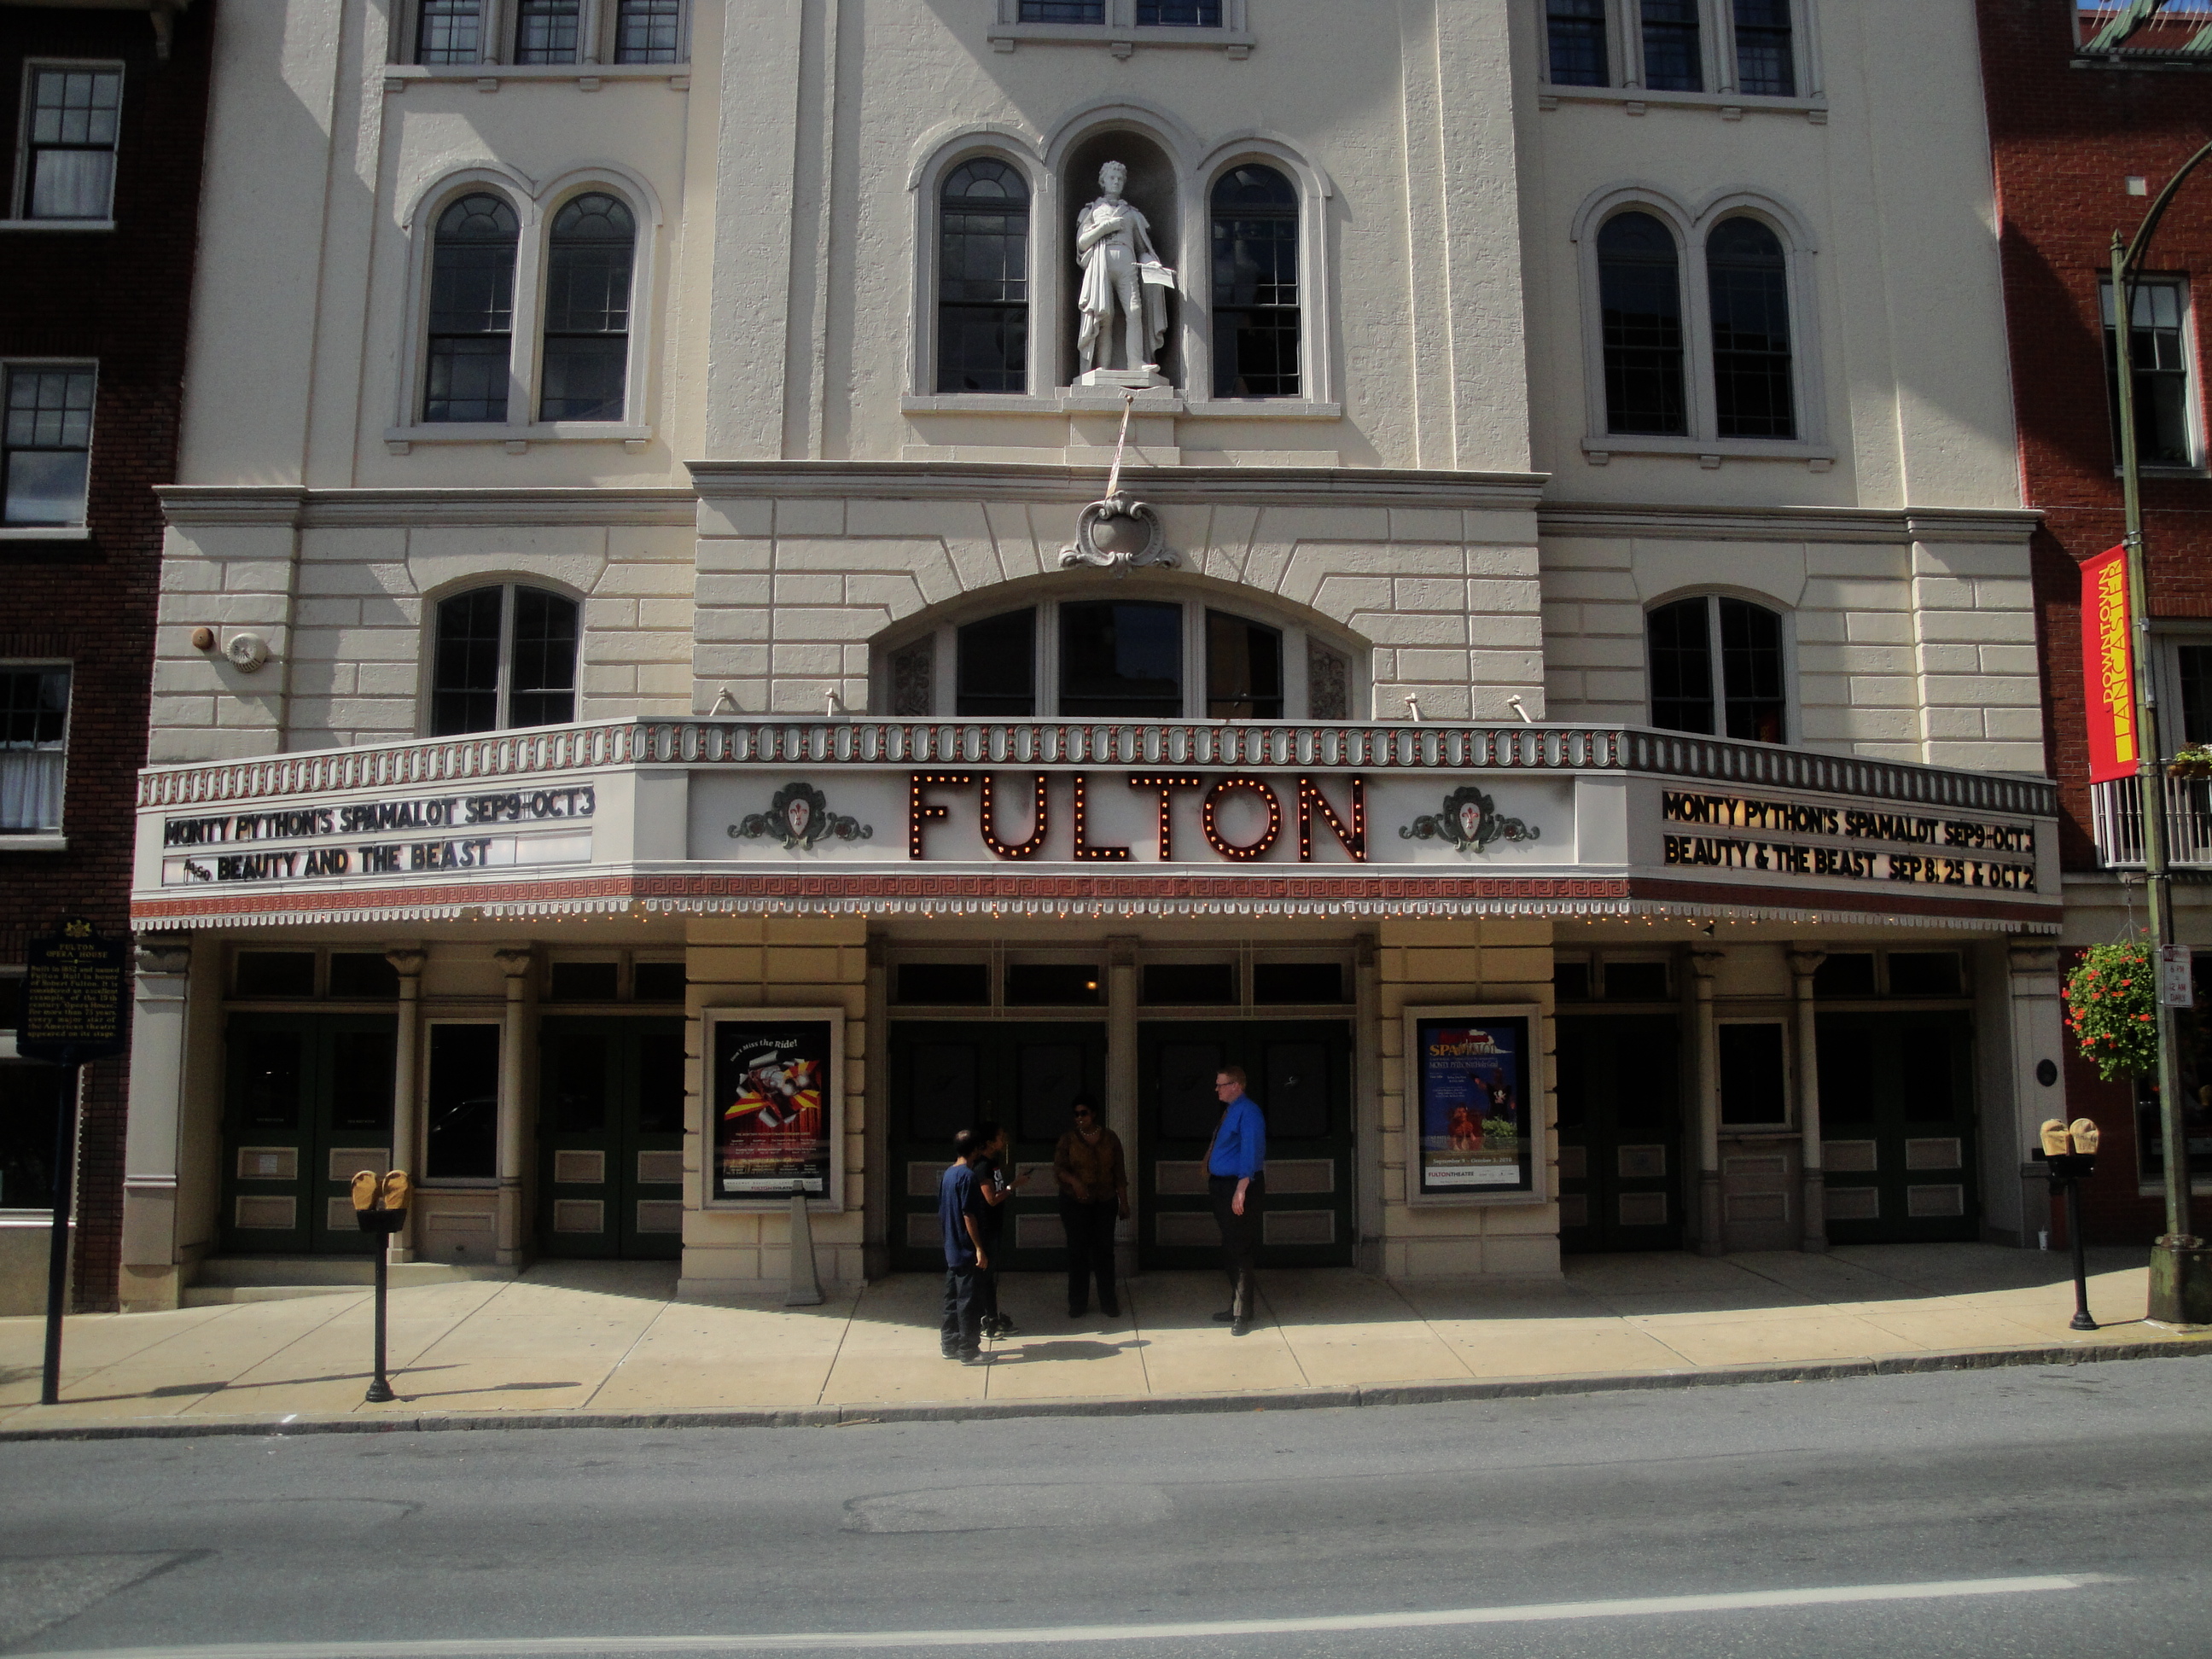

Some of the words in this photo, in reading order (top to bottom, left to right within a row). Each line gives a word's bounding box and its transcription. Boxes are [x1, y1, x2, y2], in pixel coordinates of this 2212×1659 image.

[2098, 568, 2114, 704] DOWNTOWN
[2107, 559, 2133, 741] LANCASTER
[164, 817, 230, 845] MONTY
[236, 808, 334, 840] PYTHON'S
[340, 798, 456, 831] SPAMALOT
[909, 770, 1366, 862] FULTON
[1663, 791, 1738, 825] MONTY
[1745, 800, 1838, 835] PYTHON'S
[1845, 811, 1938, 844] SPAMALOT
[218, 852, 297, 881] BEAUTY
[305, 848, 349, 876] AND
[358, 845, 400, 873] THE
[411, 838, 491, 870] BEAST
[1665, 835, 1749, 867] BEAUTY
[1755, 842, 1769, 870] &
[1773, 845, 1810, 873] THE
[1814, 848, 1876, 877] BEAST
[1889, 854, 1922, 881] SEP
[1944, 859, 1965, 884] 25
[1971, 862, 1983, 887] &
[2170, 993, 2186, 1002] DAILY
[742, 1041, 759, 1051] Miss
[774, 1039, 798, 1049] Ride!
